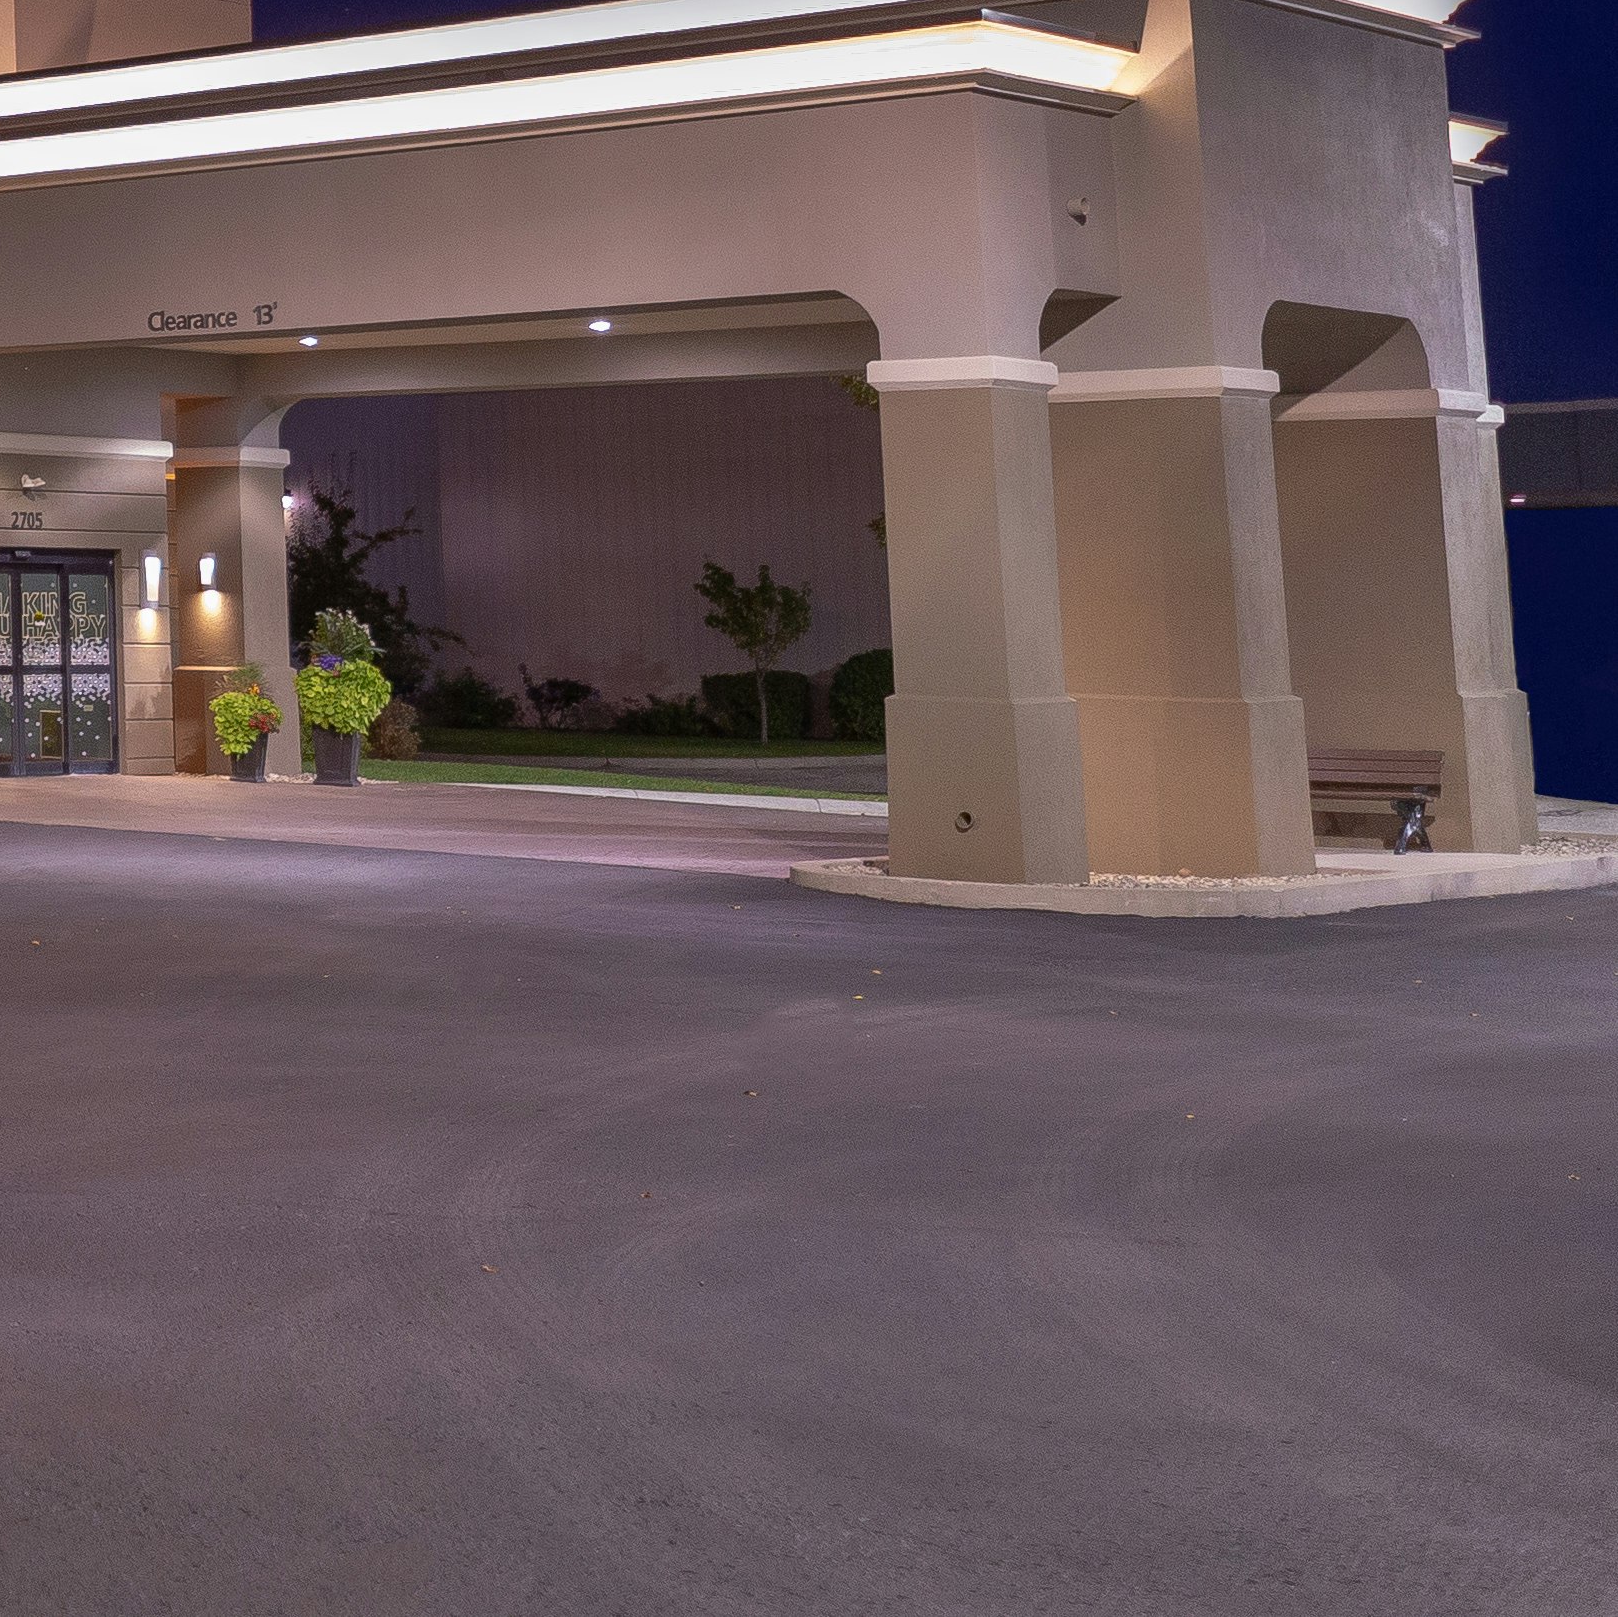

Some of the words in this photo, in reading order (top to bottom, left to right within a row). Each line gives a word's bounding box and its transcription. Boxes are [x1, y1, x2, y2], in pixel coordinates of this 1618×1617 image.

[147, 310, 238, 332] Clearance
[11, 511, 43, 530] 2705
[21, 614, 106, 639] HAPY
